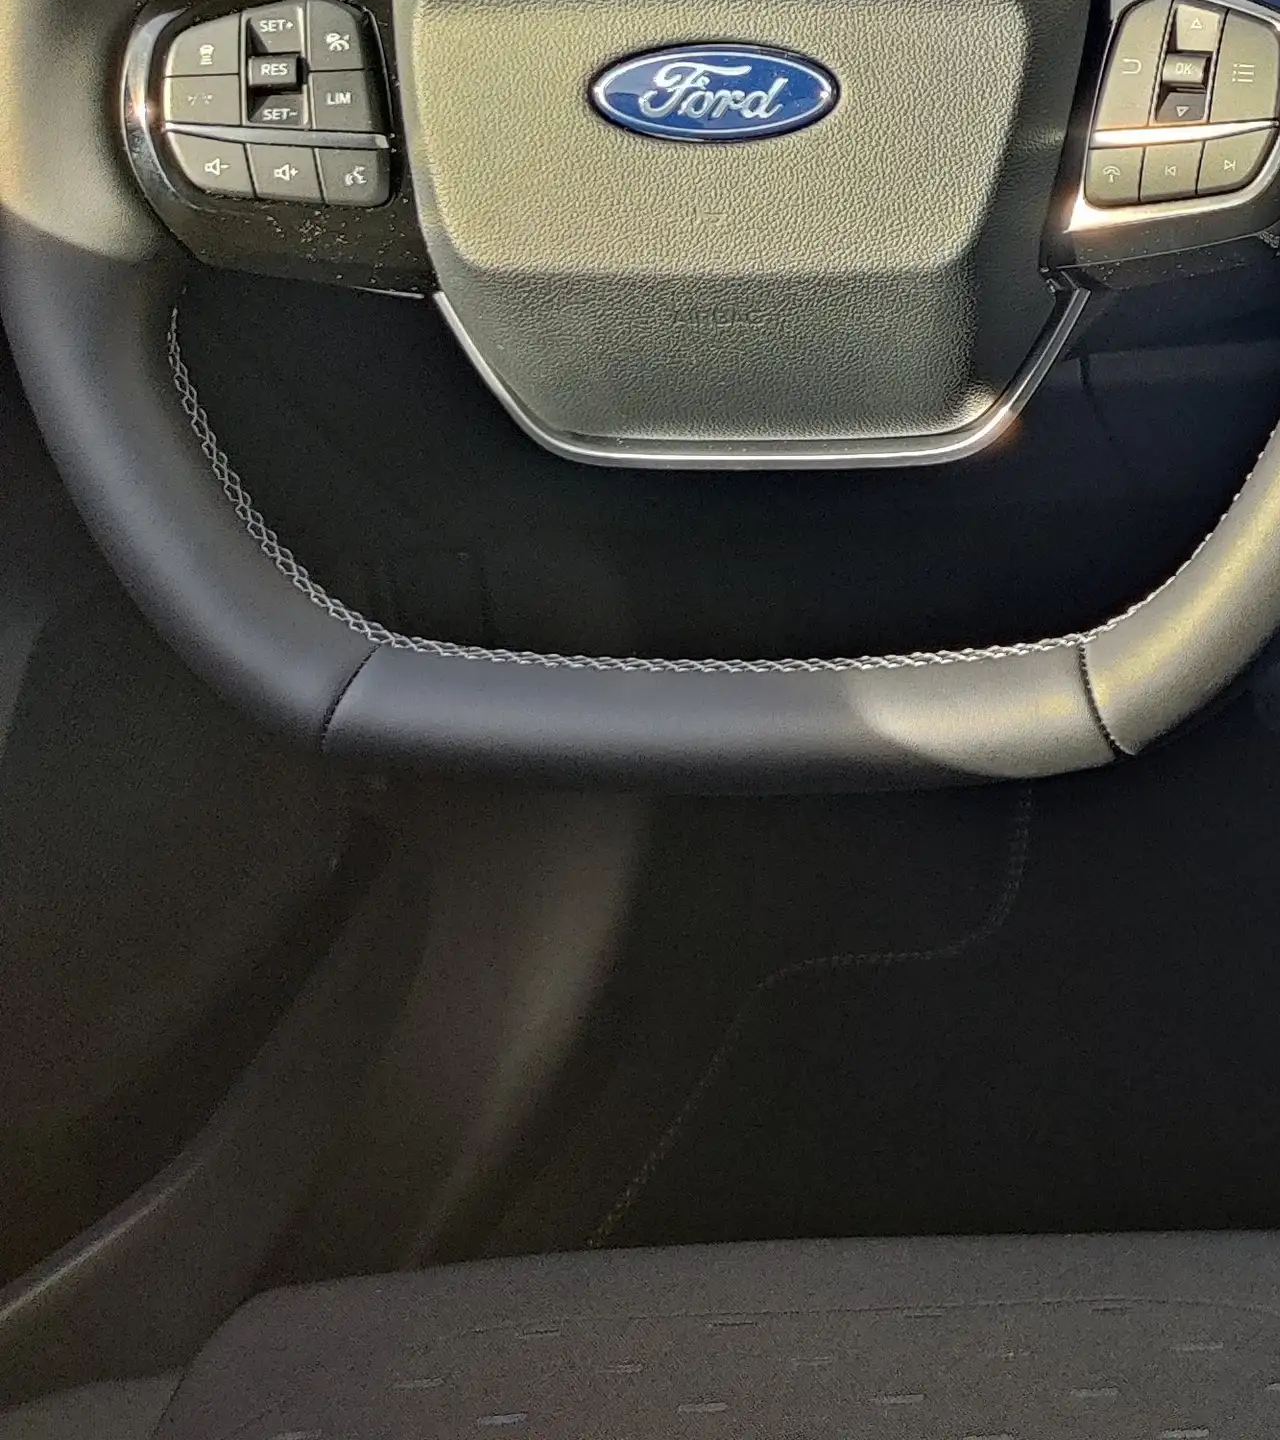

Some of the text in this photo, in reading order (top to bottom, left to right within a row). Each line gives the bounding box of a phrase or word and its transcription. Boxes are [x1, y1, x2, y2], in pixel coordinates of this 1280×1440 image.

[260, 63, 288, 76] RES
[1175, 63, 1193, 75] OK
[638, 61, 789, 120] Ford
[326, 92, 352, 105] LIM
